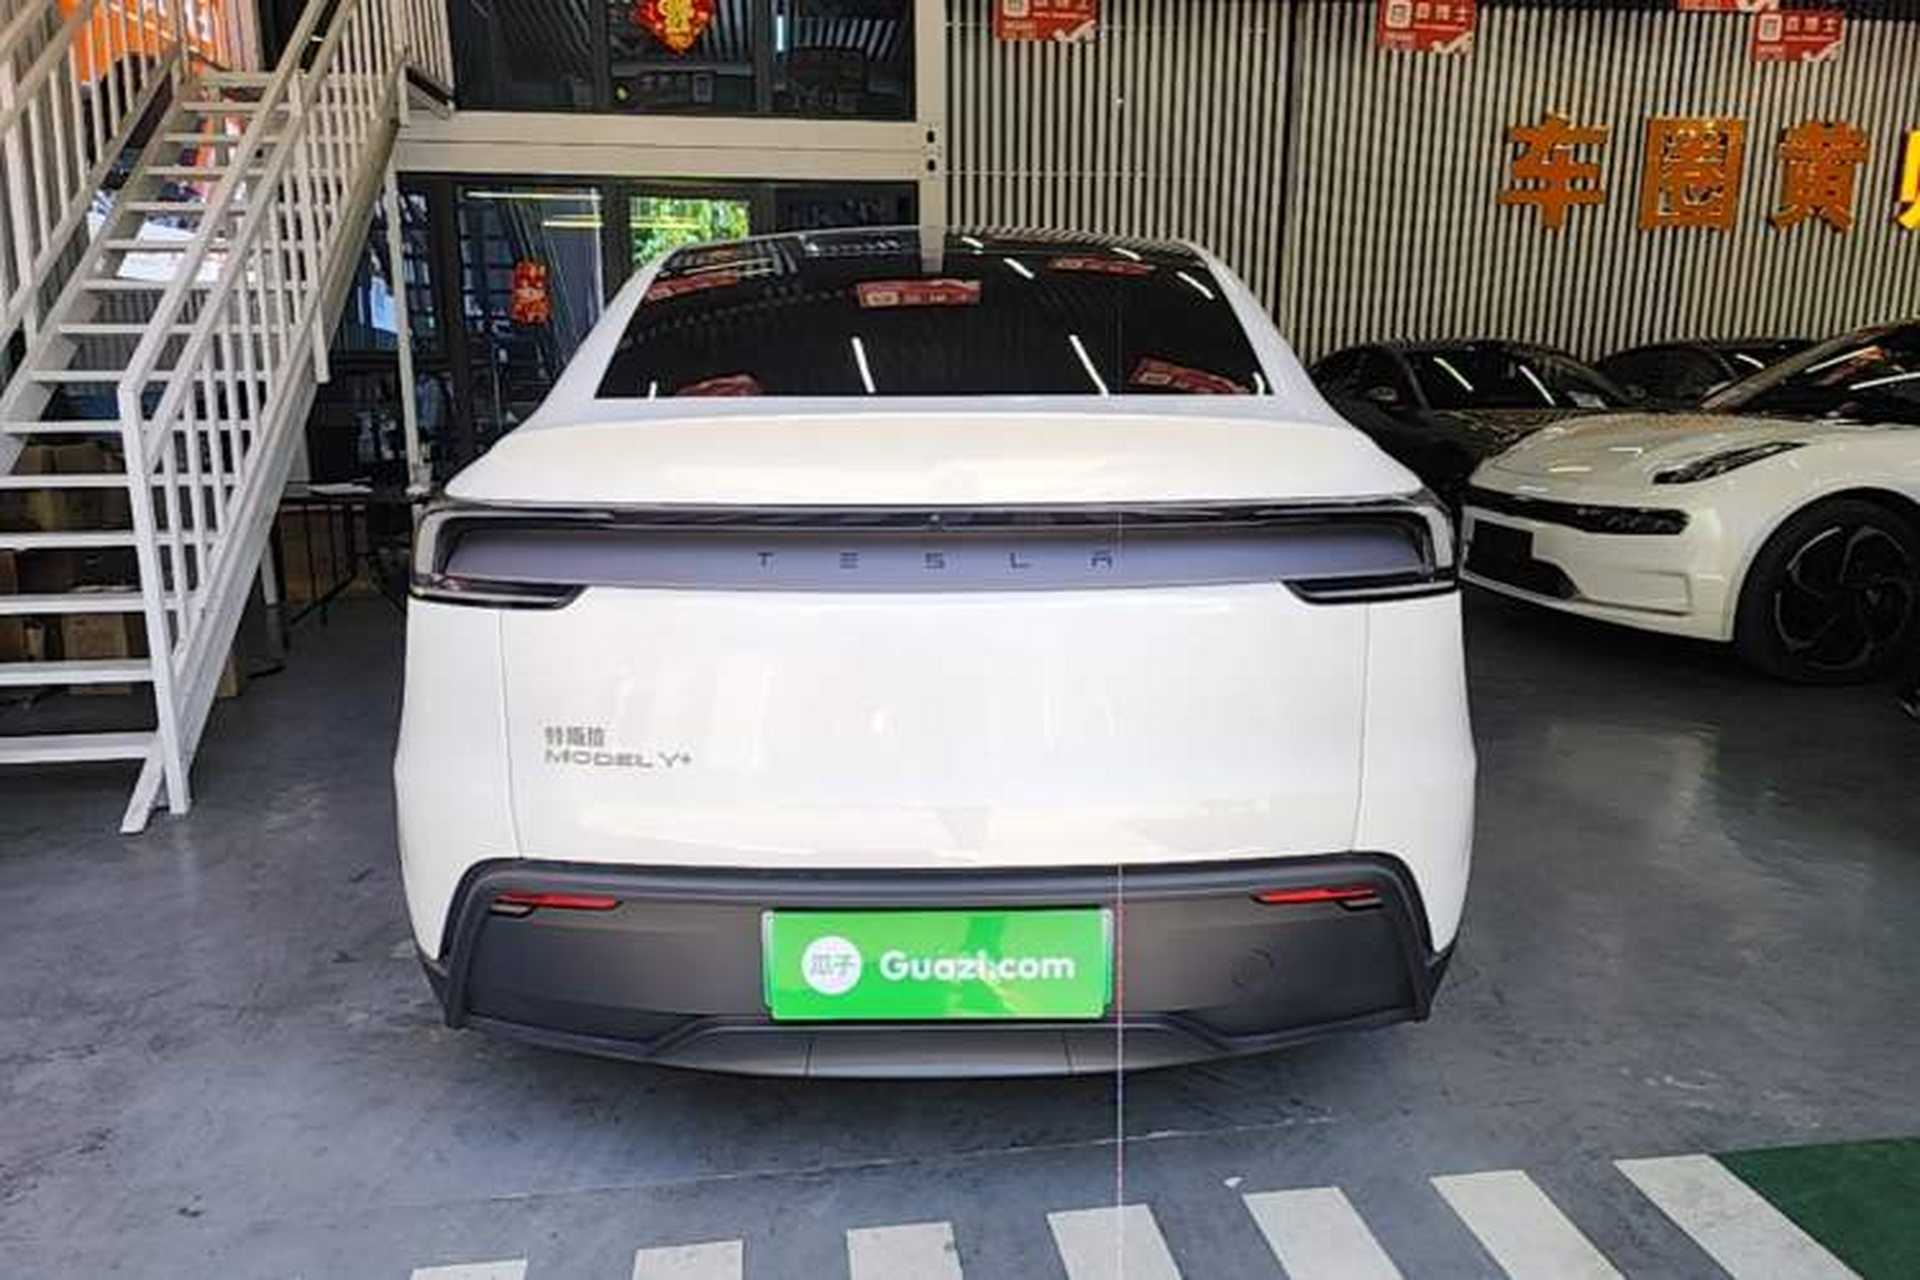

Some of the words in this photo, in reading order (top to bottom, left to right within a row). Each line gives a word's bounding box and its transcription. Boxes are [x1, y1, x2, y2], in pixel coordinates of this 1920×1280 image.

[1499, 110, 1920, 233] 车圈黄
[756, 551, 1114, 570] TESLA
[544, 749, 653, 768] MODEL
[879, 947, 1076, 983] Guazi.com
